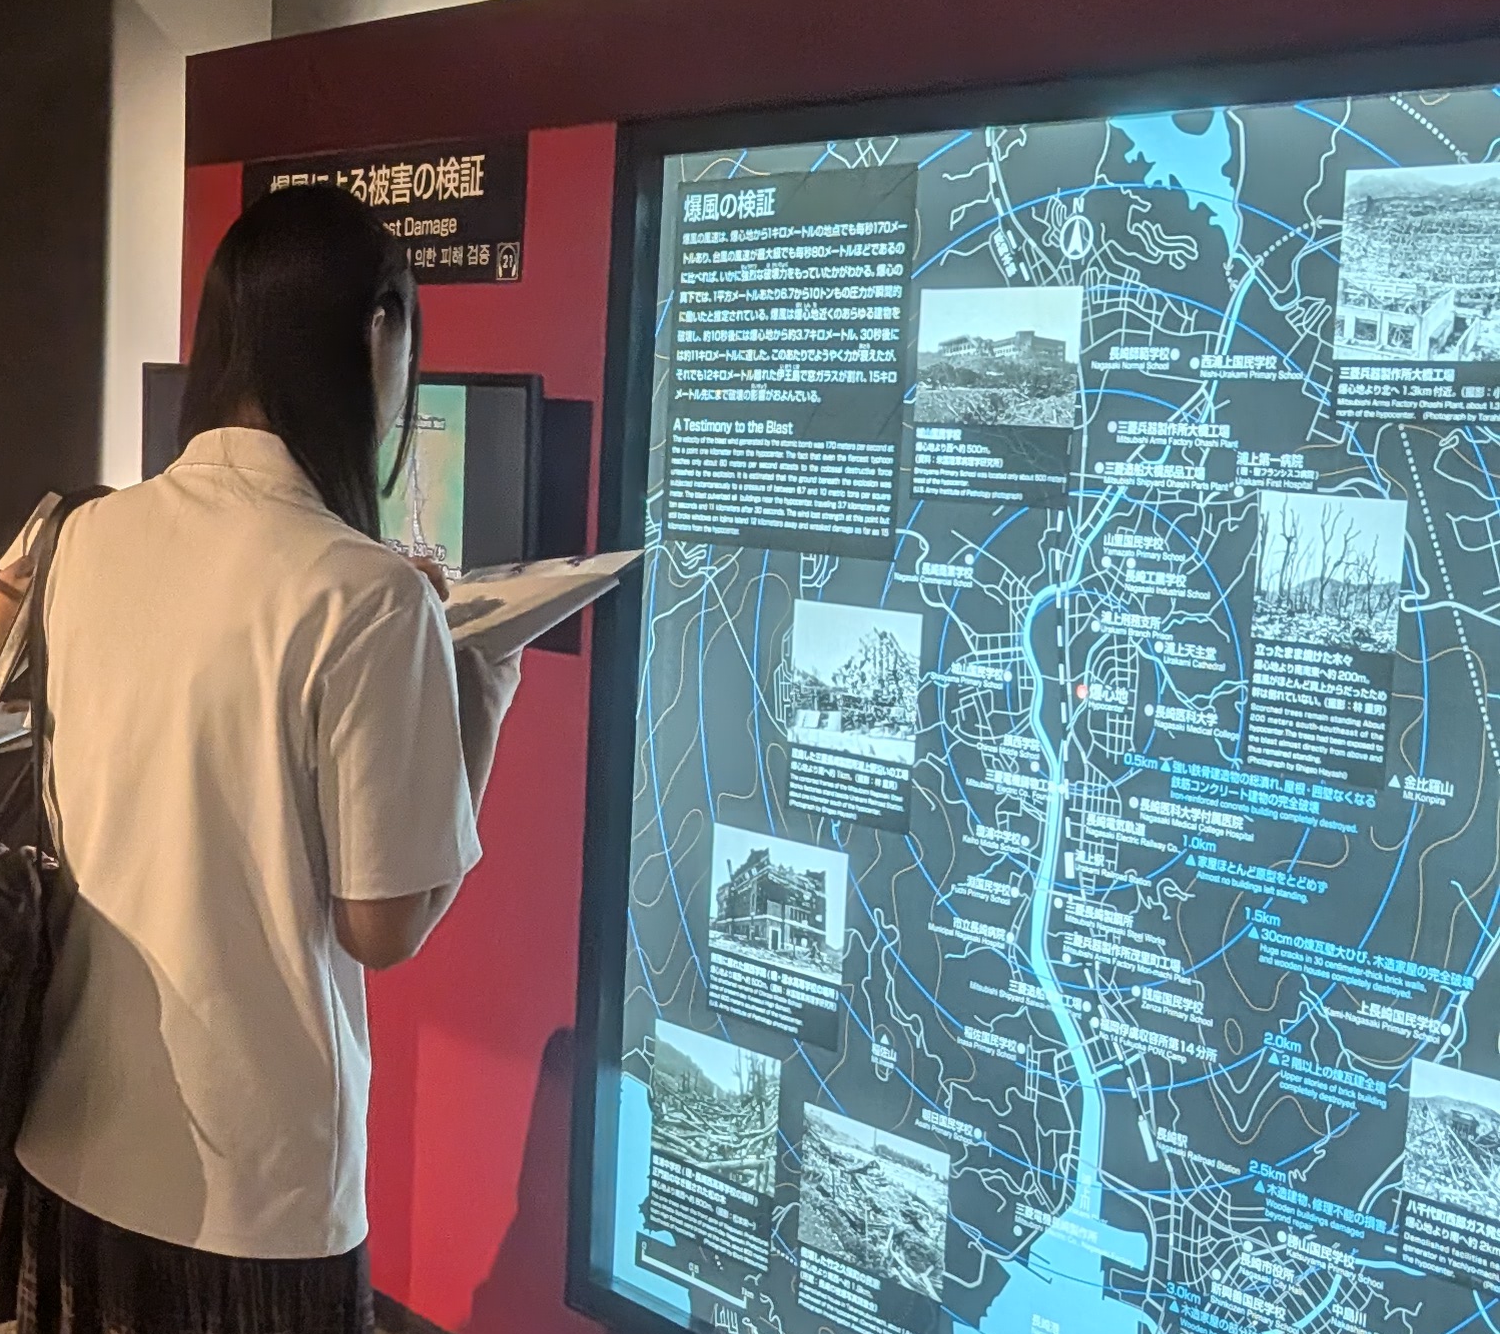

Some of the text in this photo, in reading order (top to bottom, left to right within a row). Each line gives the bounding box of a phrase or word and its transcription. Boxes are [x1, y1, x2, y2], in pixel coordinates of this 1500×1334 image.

[684, 188, 776, 222] 爆風の検証
[1073, 197, 1085, 213] N
[404, 217, 457, 237] Damage
[1250, 371, 1277, 381] Primary
[1279, 371, 1303, 380] School
[673, 418, 794, 435] A Testimony to the Blast
[1124, 753, 1159, 769] 0.5km
[1183, 834, 1217, 852] 1.0km
[1245, 907, 1281, 927] 1.5km
[1264, 1032, 1302, 1053] 2.0km
[1249, 1160, 1287, 1183] 2.5km
[1166, 1282, 1201, 1305] 3.0km
[1331, 1302, 1367, 1328] 中島川
